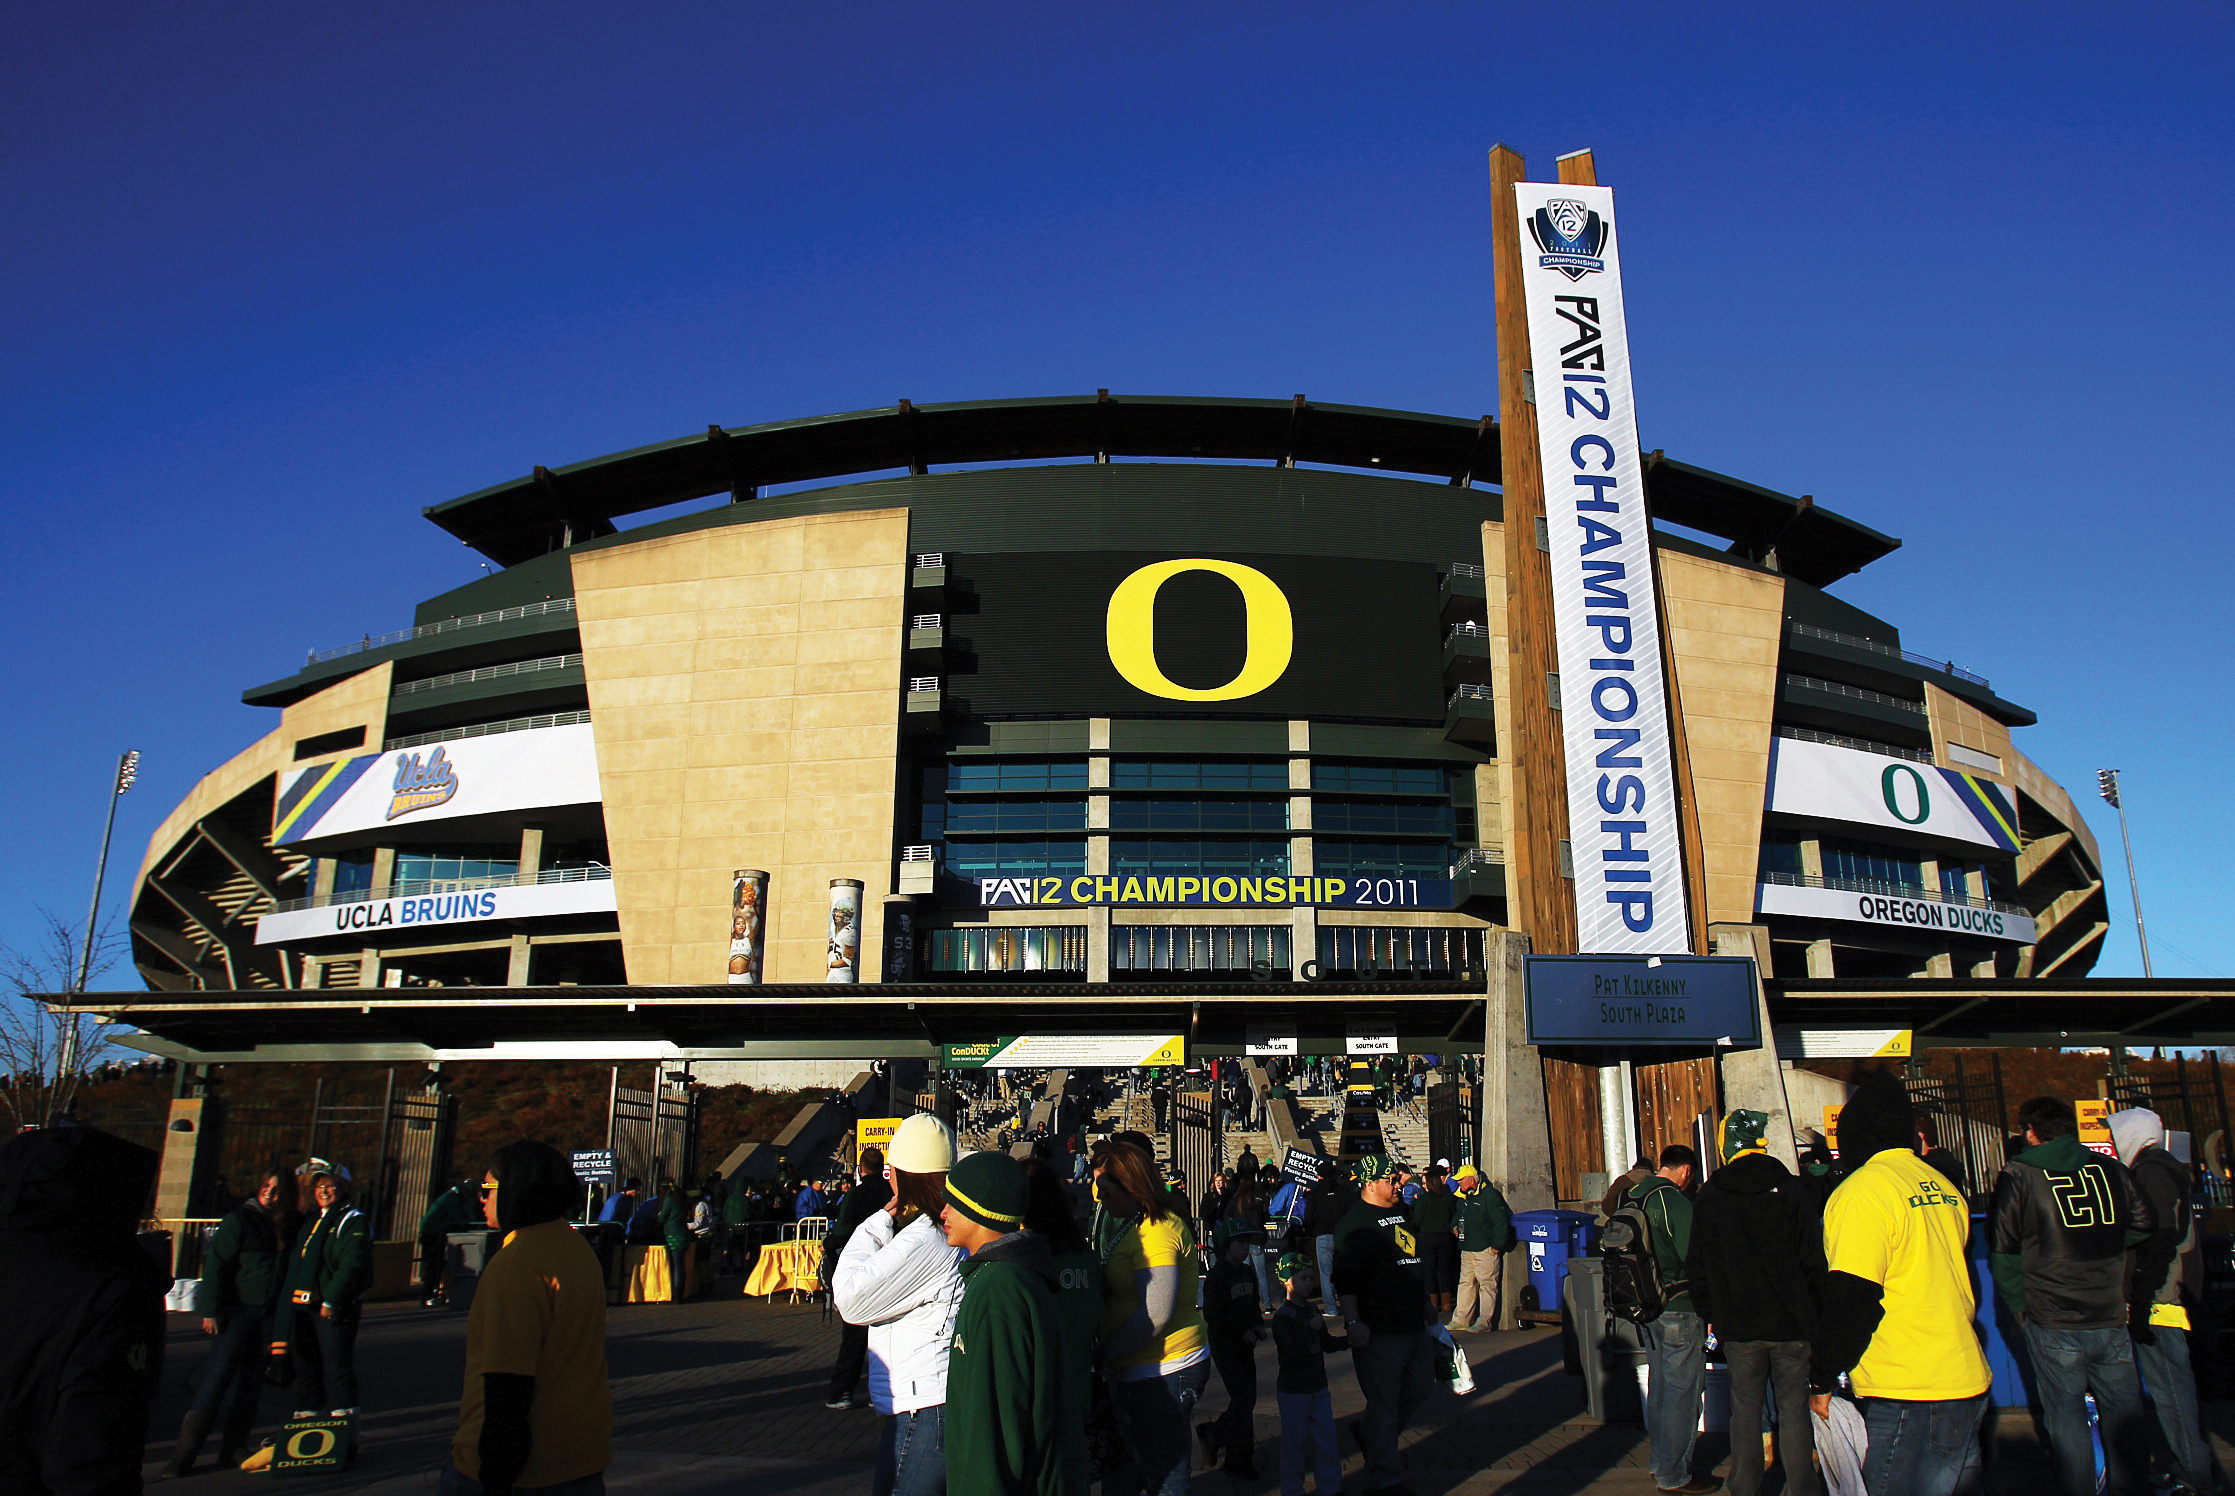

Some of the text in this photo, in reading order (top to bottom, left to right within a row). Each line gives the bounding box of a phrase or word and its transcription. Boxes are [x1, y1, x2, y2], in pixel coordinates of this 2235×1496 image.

[1562, 220, 1577, 231] 12
[1550, 246, 1592, 254] FOOTBALL
[1543, 257, 1600, 268] CHAMPIONSHIP
[1570, 434, 1654, 933] CHAMPIONSHIP
[1071, 876, 1347, 904] CHAMPIONSHIP
[1355, 878, 1419, 906] 2011
[336, 892, 496, 931] UCLA BRUINS
[1859, 896, 2005, 935] OREGON DUCKS
[865, 1127, 895, 1137] CARRY-IN
[573, 1151, 611, 1160] EMPTY &
[1290, 1150, 1317, 1165] EMPTY
[572, 1160, 612, 1169] RECYCLE
[1287, 1157, 1319, 1176] RECYCL
[1919, 1180, 1940, 1193] GO
[1908, 1194, 1959, 1208] DUCKS
[2043, 1164, 2115, 1228] 21
[283, 1419, 348, 1430] OREGON
[276, 1457, 337, 1469] DUCKS
